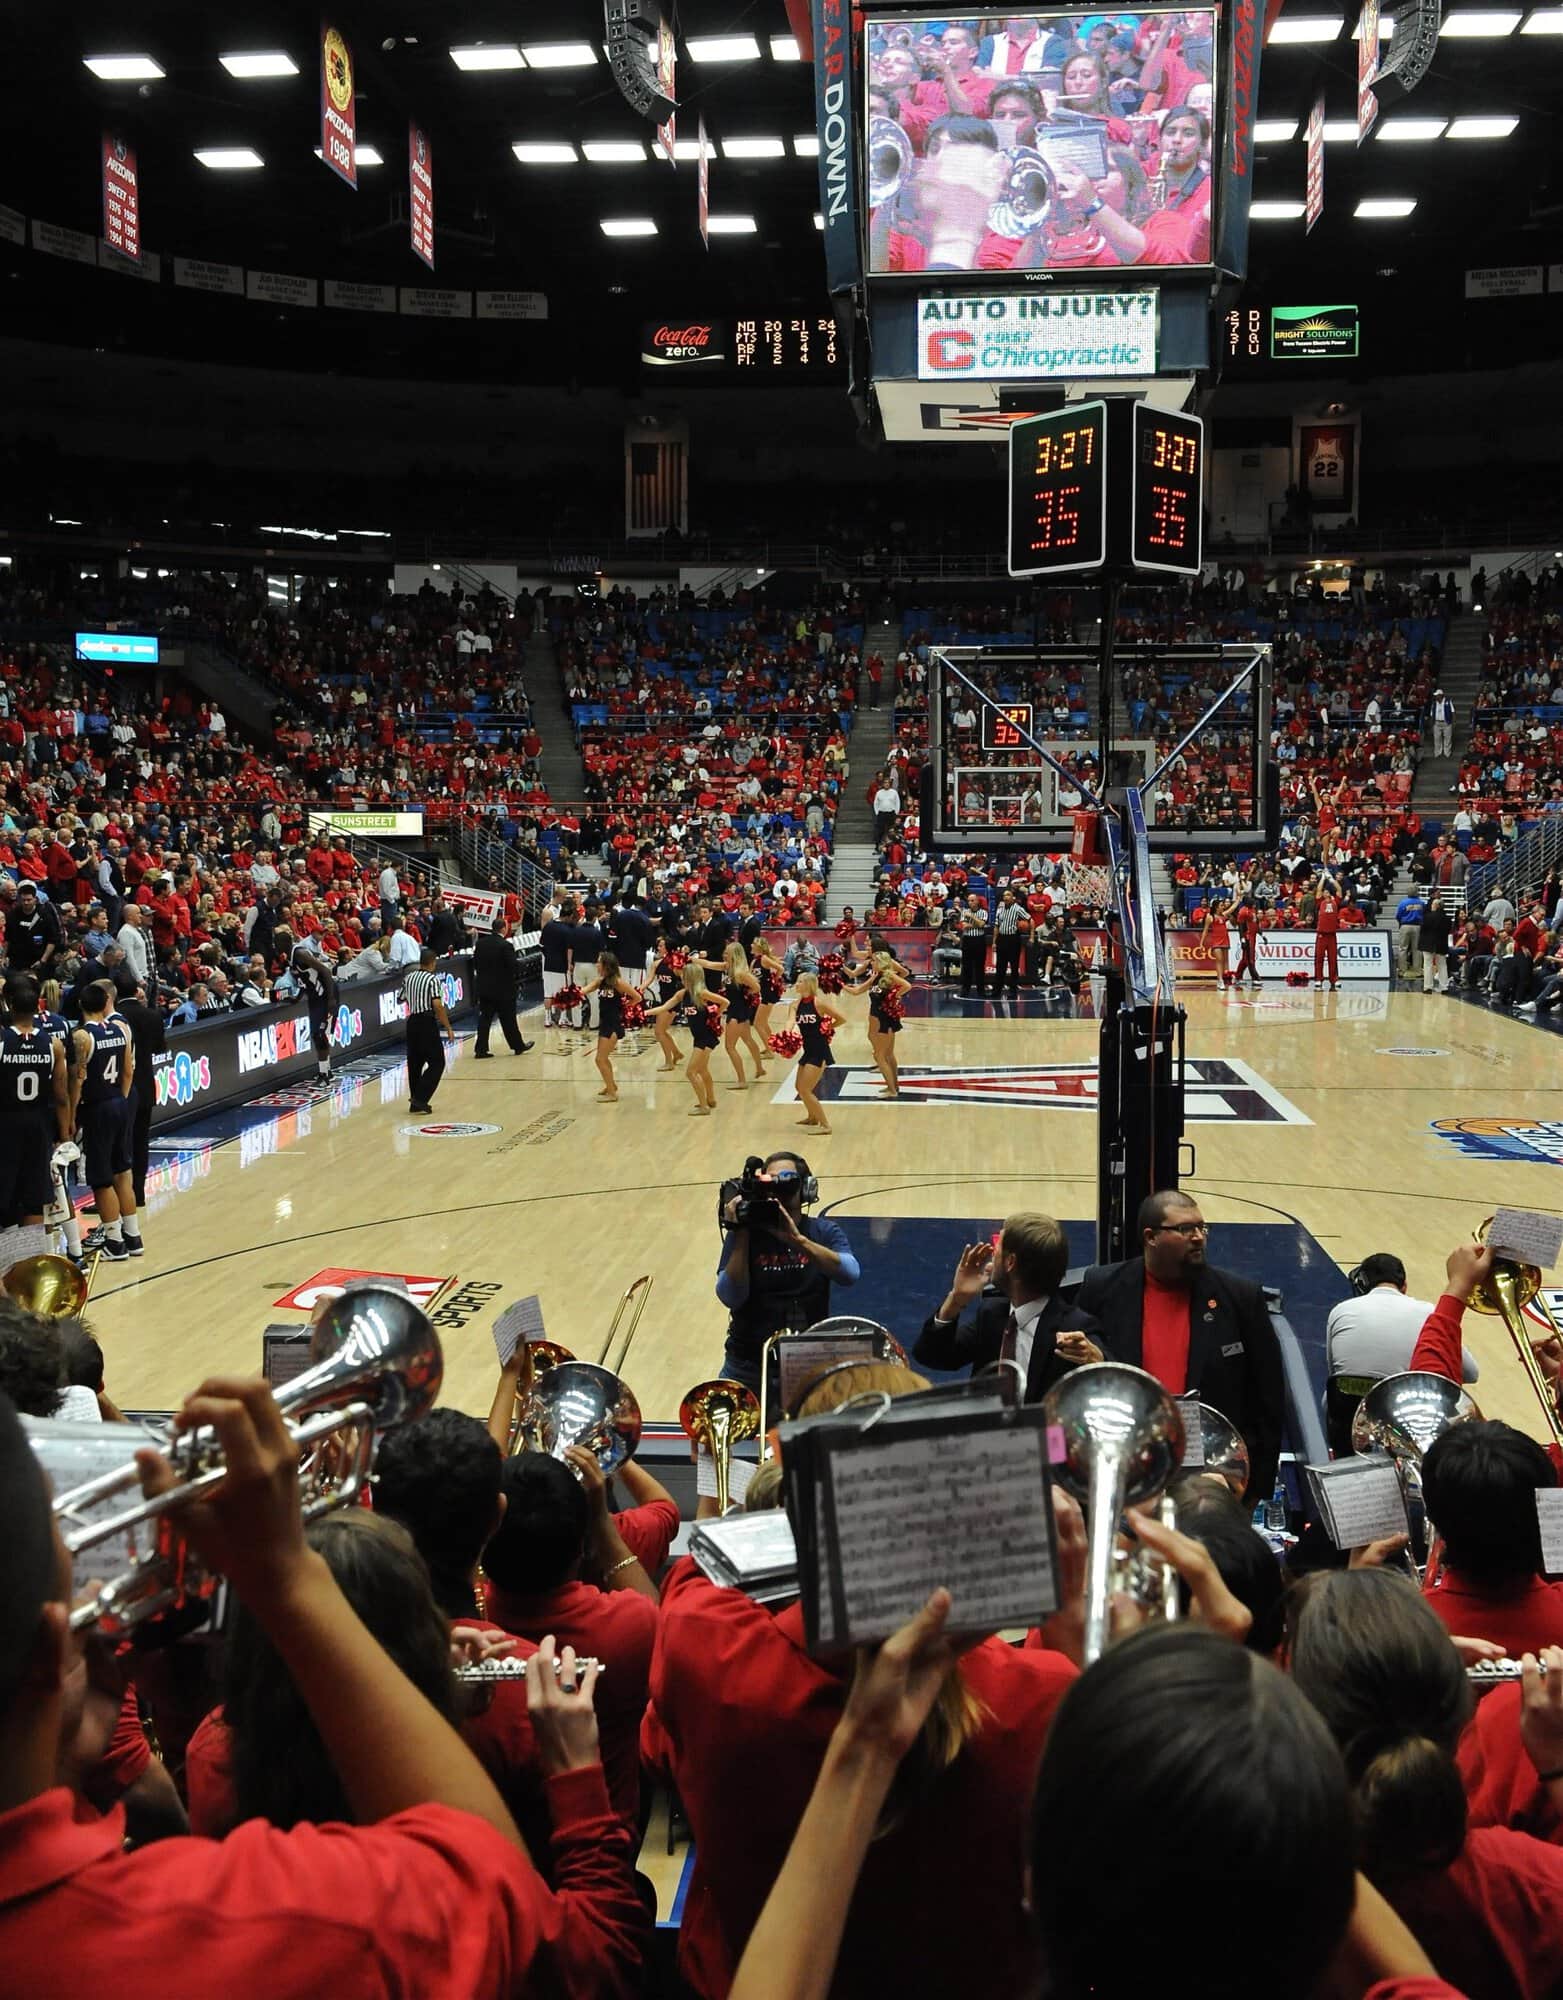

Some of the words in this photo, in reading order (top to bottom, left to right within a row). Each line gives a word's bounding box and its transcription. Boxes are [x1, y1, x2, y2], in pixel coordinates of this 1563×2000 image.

[823, 0, 843, 90] EAR
[330, 136, 350, 170] 1988
[922, 300, 1006, 320] AUTO
[1018, 296, 1152, 319] INJURY?
[736, 333, 757, 343] PTS
[766, 332, 782, 342] 18
[800, 332, 809, 341] 5
[828, 331, 836, 341] 7
[764, 321, 782, 331] 20
[791, 320, 806, 331] 21
[818, 319, 836, 330] 24
[1274, 331, 1305, 339] BRIGHT
[1306, 330, 1353, 338] SOLUTIONS
[738, 344, 755, 354] RB
[773, 343, 782, 354] 2
[800, 342, 809, 352] 4
[827, 342, 836, 352] 4
[773, 354, 782, 365] 2
[800, 353, 809, 364] 4
[827, 353, 836, 363] 0
[981, 344, 1141, 371] Chiropractic
[1035, 427, 1094, 474] 3:27
[1153, 430, 1196, 475] 3:27
[1314, 461, 1338, 478] 22
[1031, 486, 1080, 549] 35
[1149, 486, 1187, 547] 35
[334, 816, 394, 826] SUNSTREET
[1171, 946, 1217, 960] ARGO
[1260, 946, 1316, 958] WILDC
[1338, 946, 1381, 958] CLUB
[96, 1037, 126, 1049] HERRERA
[238, 1028, 270, 1074] NBA
[3, 1054, 51, 1064] MARHOLD
[103, 1055, 118, 1084] 4
[17, 1071, 39, 1101] 0
[432, 1281, 503, 1328] SPORTS
